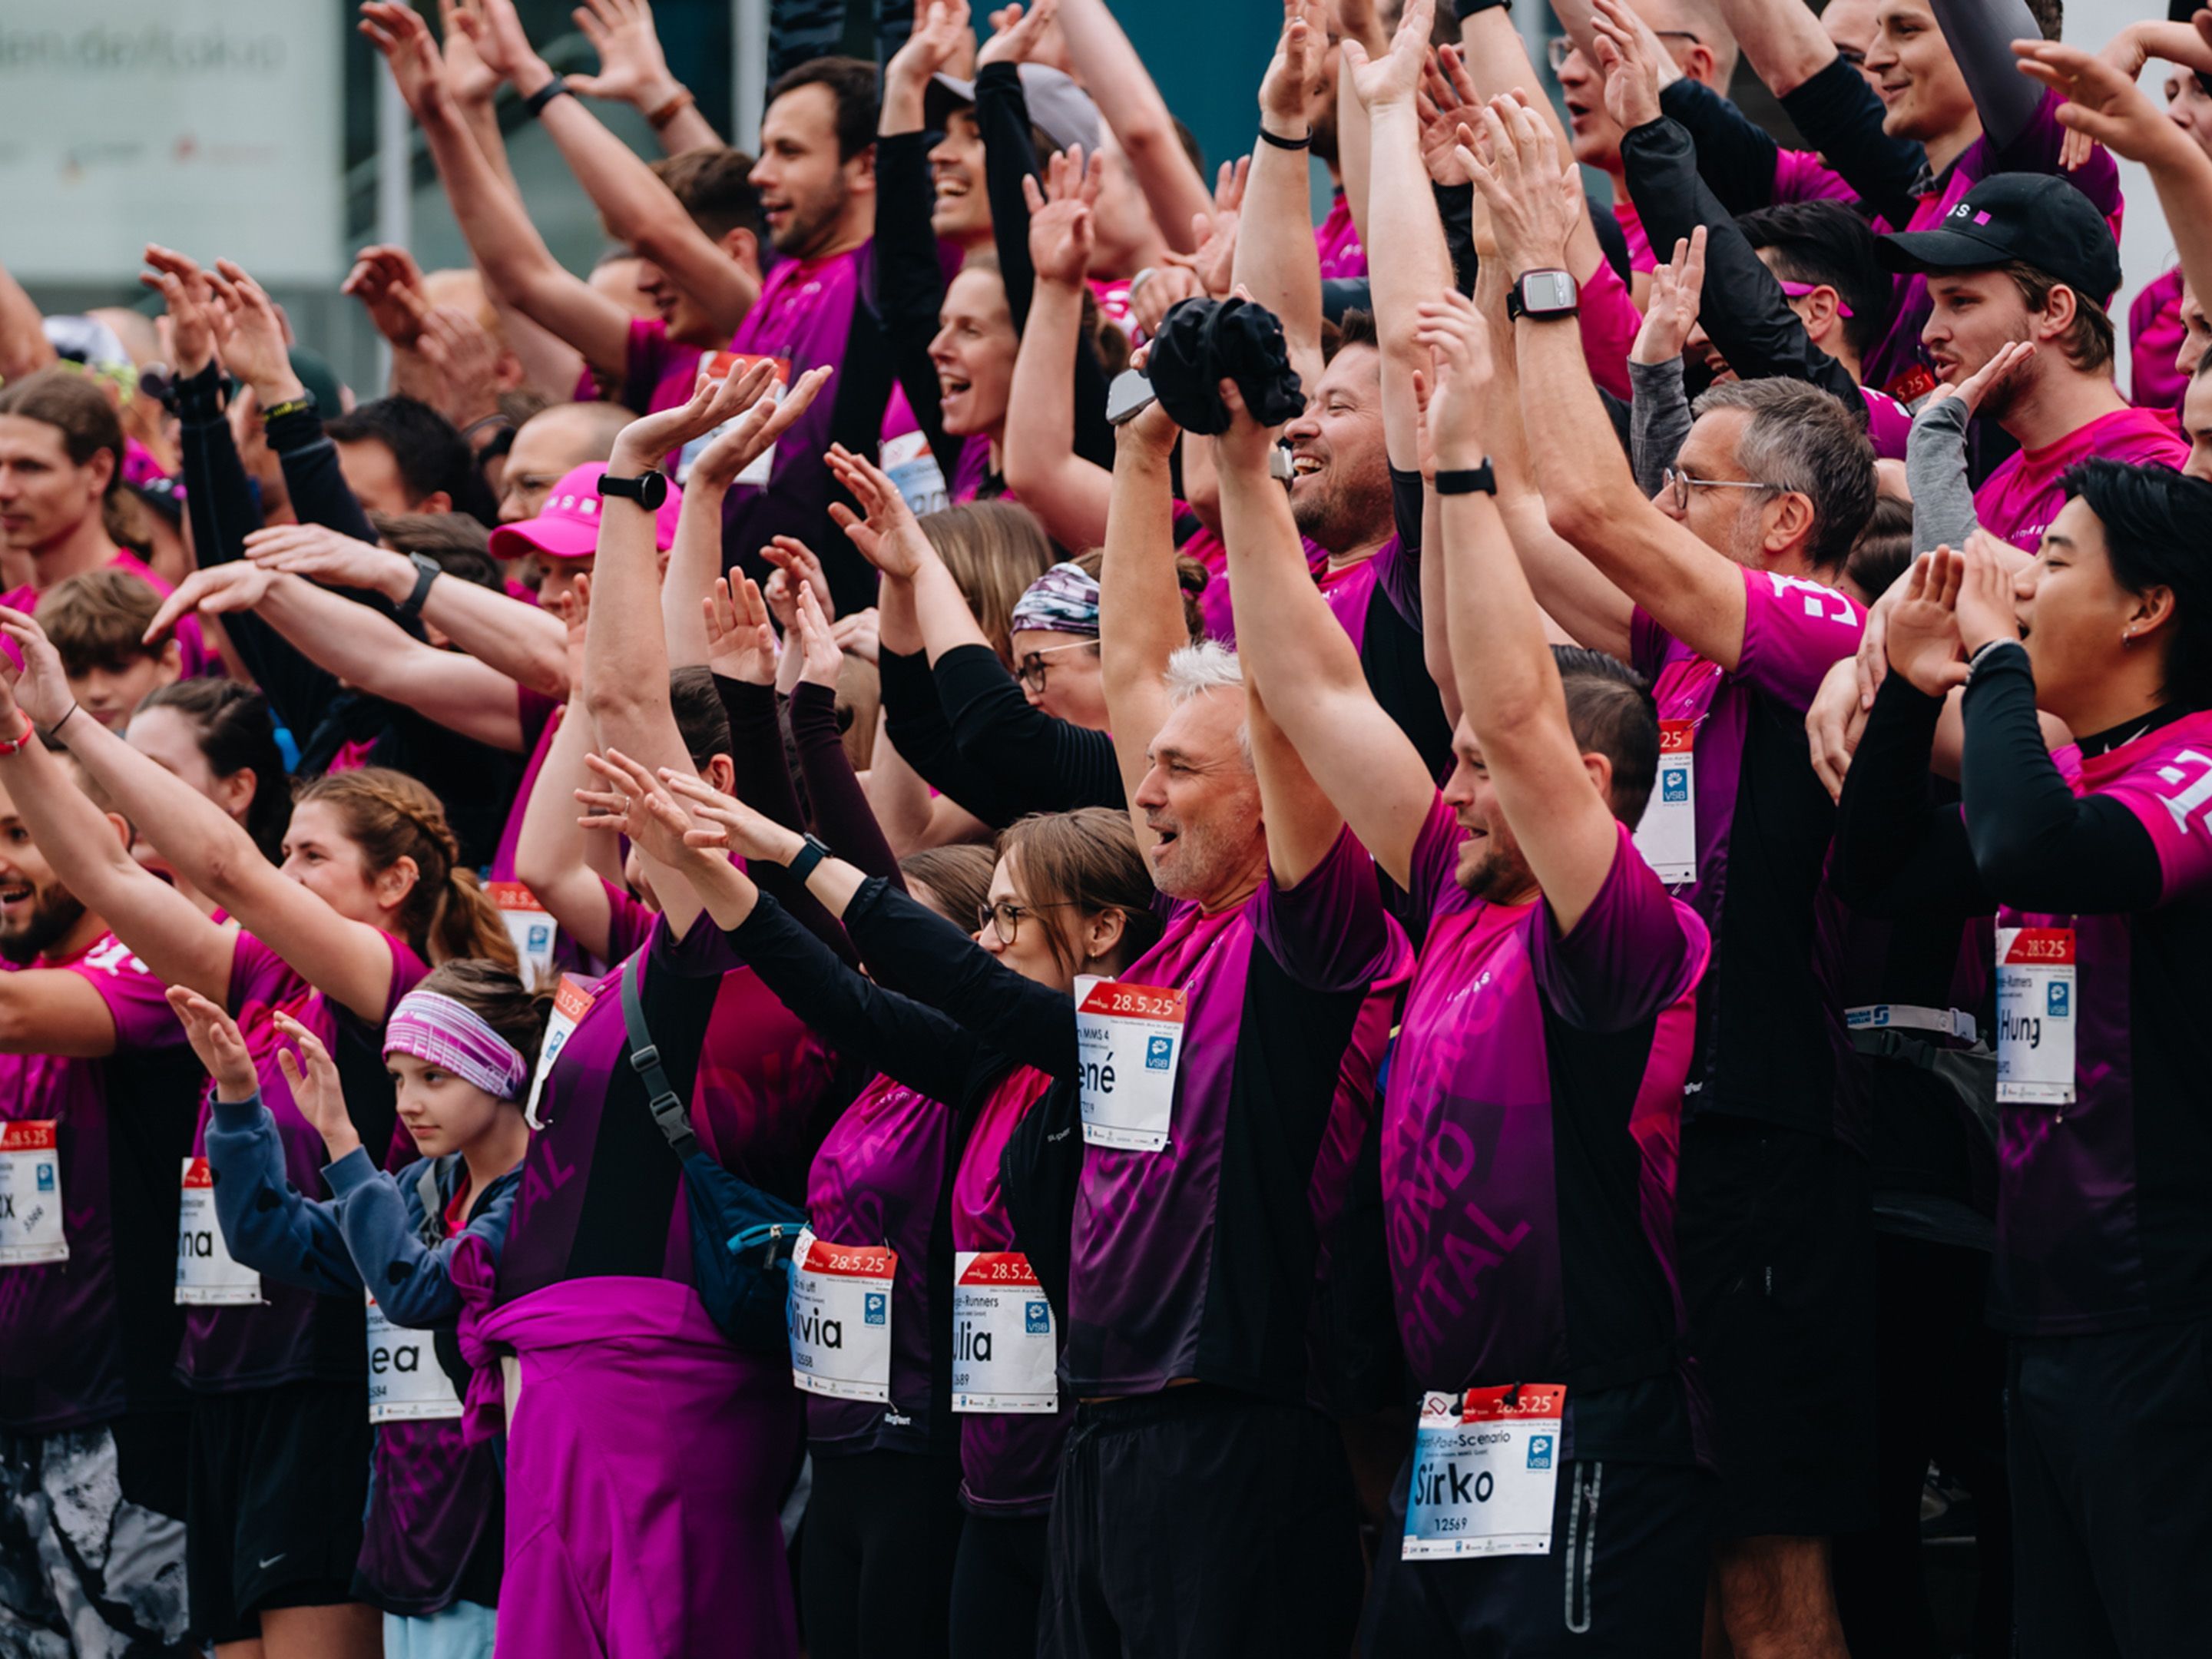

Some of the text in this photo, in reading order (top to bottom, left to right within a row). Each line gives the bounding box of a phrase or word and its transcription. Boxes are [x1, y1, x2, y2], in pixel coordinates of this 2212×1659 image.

[1665, 790, 1686, 800] VSB
[1112, 993, 1174, 1016] 28.5.25
[2000, 1008, 2041, 1049] Hung
[1147, 1058, 1168, 1068] VSB
[829, 1253, 886, 1273] 28.5.25
[991, 1263, 1038, 1280] 28.5.2
[789, 1300, 842, 1349] livia
[1027, 1323, 1048, 1333] VSB
[372, 1345, 419, 1375] ea
[1528, 1457, 1549, 1468] VSB
[1414, 1462, 1494, 1506] Sirko
[1434, 1517, 1468, 1532] 12569
